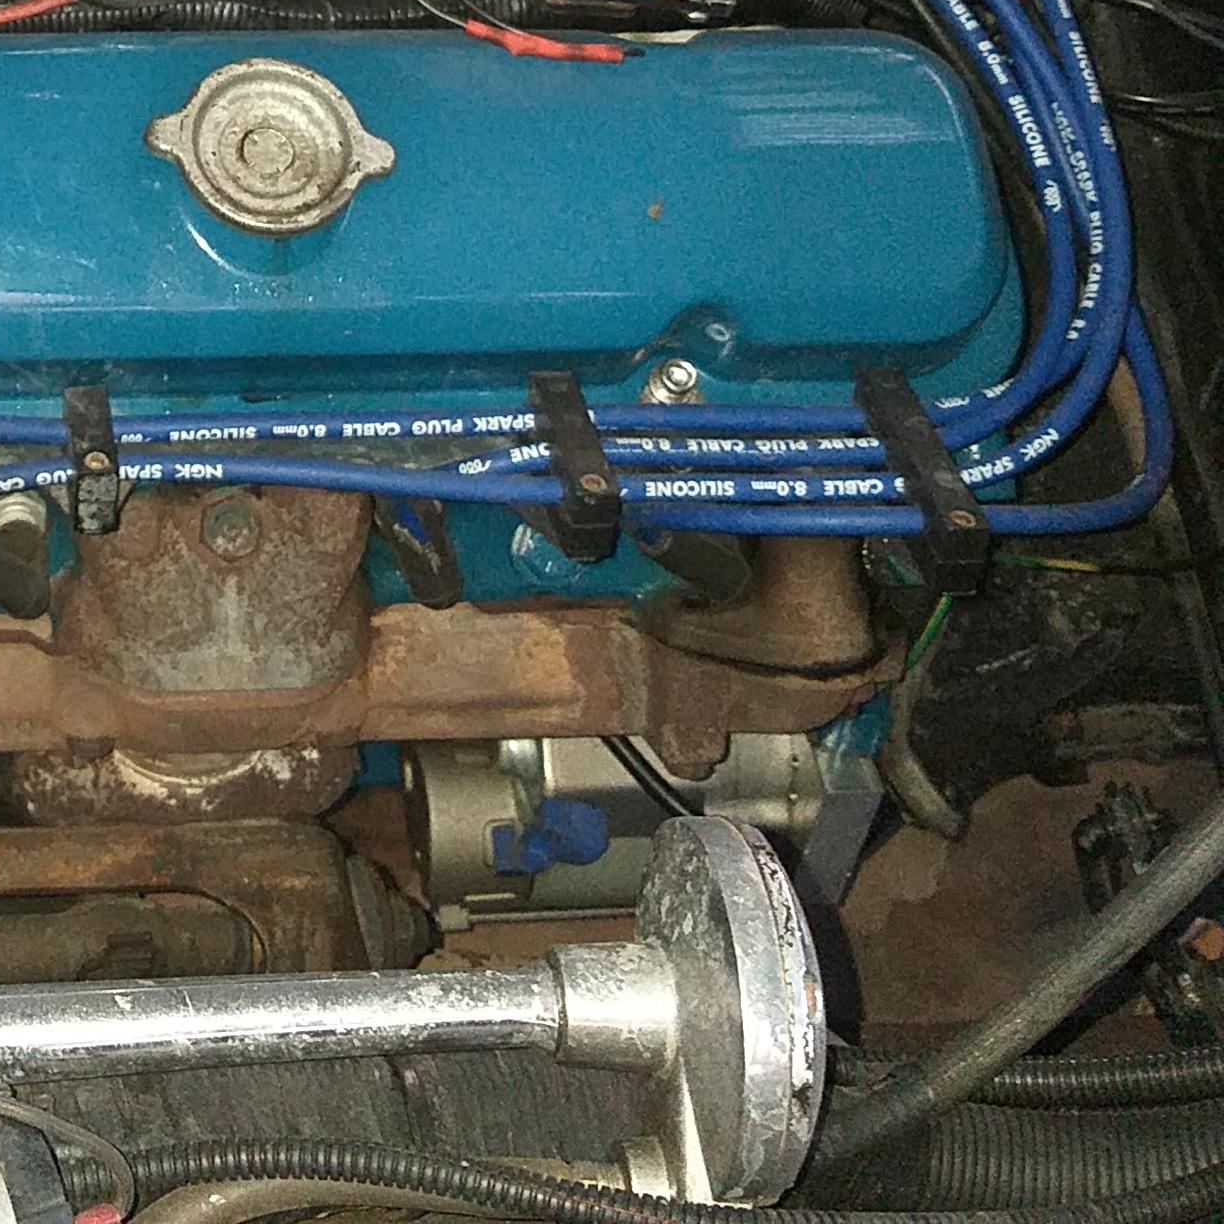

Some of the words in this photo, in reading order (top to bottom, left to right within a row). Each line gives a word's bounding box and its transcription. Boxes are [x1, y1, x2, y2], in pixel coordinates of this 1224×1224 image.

[1069, 30, 1103, 104] SILICONE
[977, 39, 1008, 85] 8.0mm
[1008, 94, 1051, 167] SILICONE
[1079, 262, 1103, 309] CABLE
[272, 424, 327, 438] 8.0mm
[342, 421, 401, 437] CABLE
[411, 418, 463, 435] PLUG
[473, 413, 535, 432] SPARK
[169, 425, 257, 442] SILICONE
[686, 438, 745, 453] CABLE
[755, 439, 809, 453] PLUG
[1019, 428, 1059, 462] NGK
[174, 463, 223, 479] NGK
[645, 480, 736, 497] SILICONE
[750, 480, 808, 497] 8.0mm
[823, 478, 884, 496] CABLE
